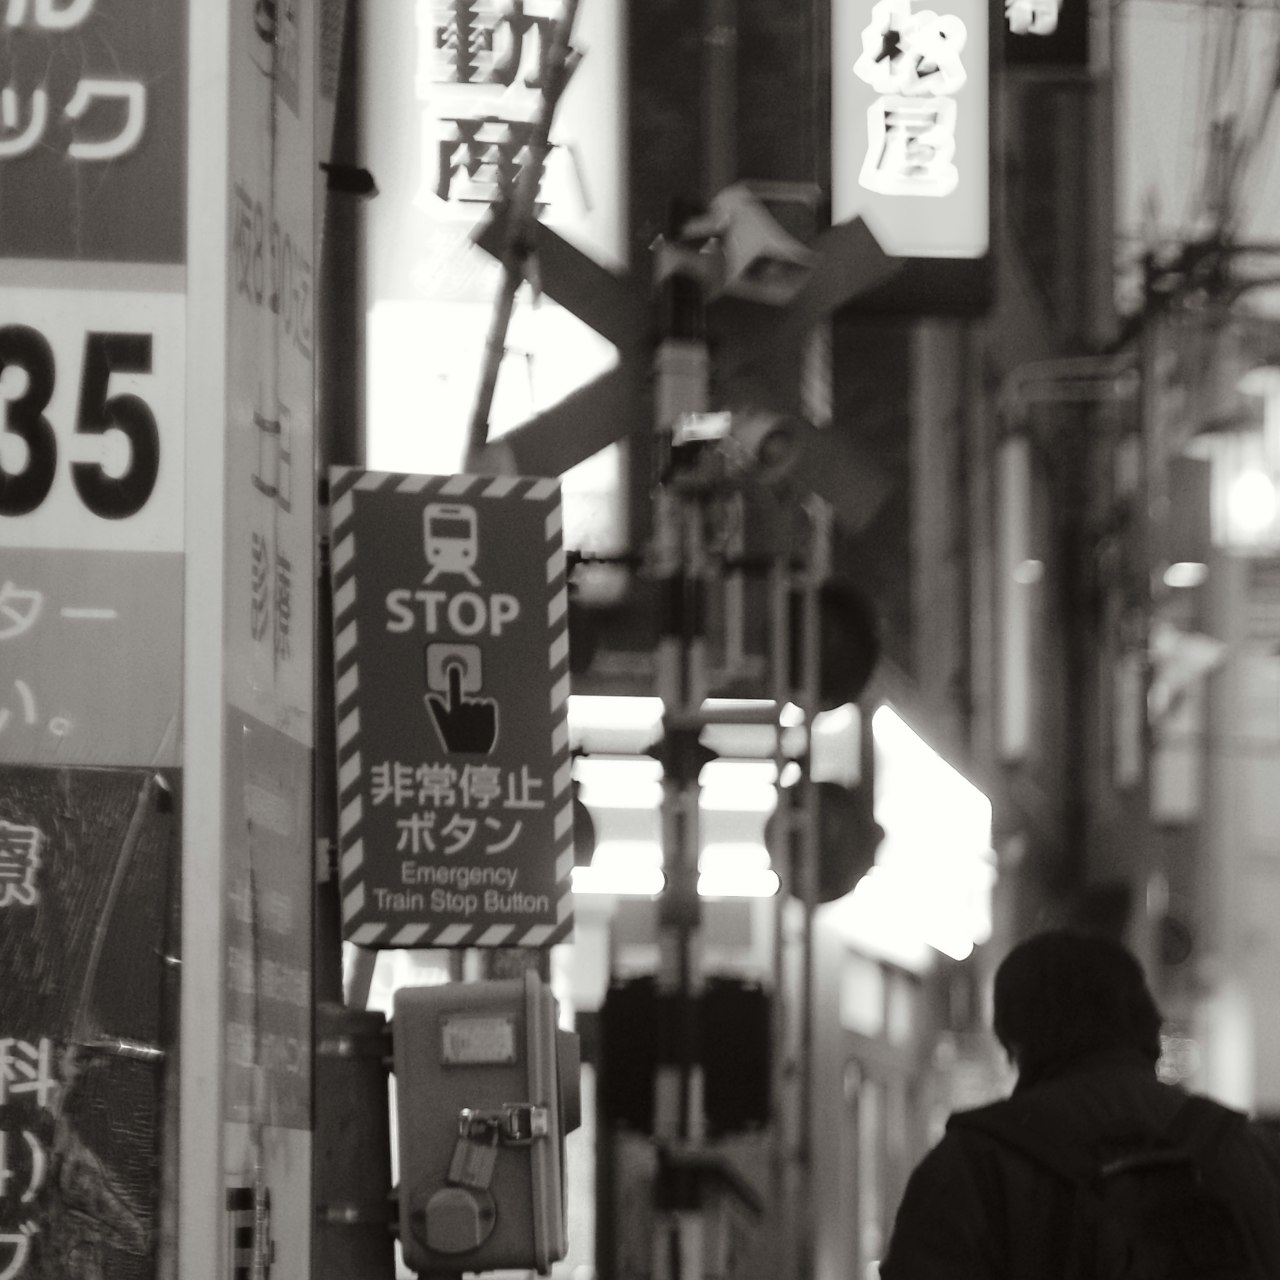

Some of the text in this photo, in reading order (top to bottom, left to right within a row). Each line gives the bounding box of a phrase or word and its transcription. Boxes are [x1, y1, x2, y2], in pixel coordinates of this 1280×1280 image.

[385, 588, 521, 636] STOP
[370, 760, 546, 810] 非常停止
[395, 810, 523, 856] ボタン
[401, 860, 519, 891] Emergency
[372, 887, 550, 918] Train Stop Button
